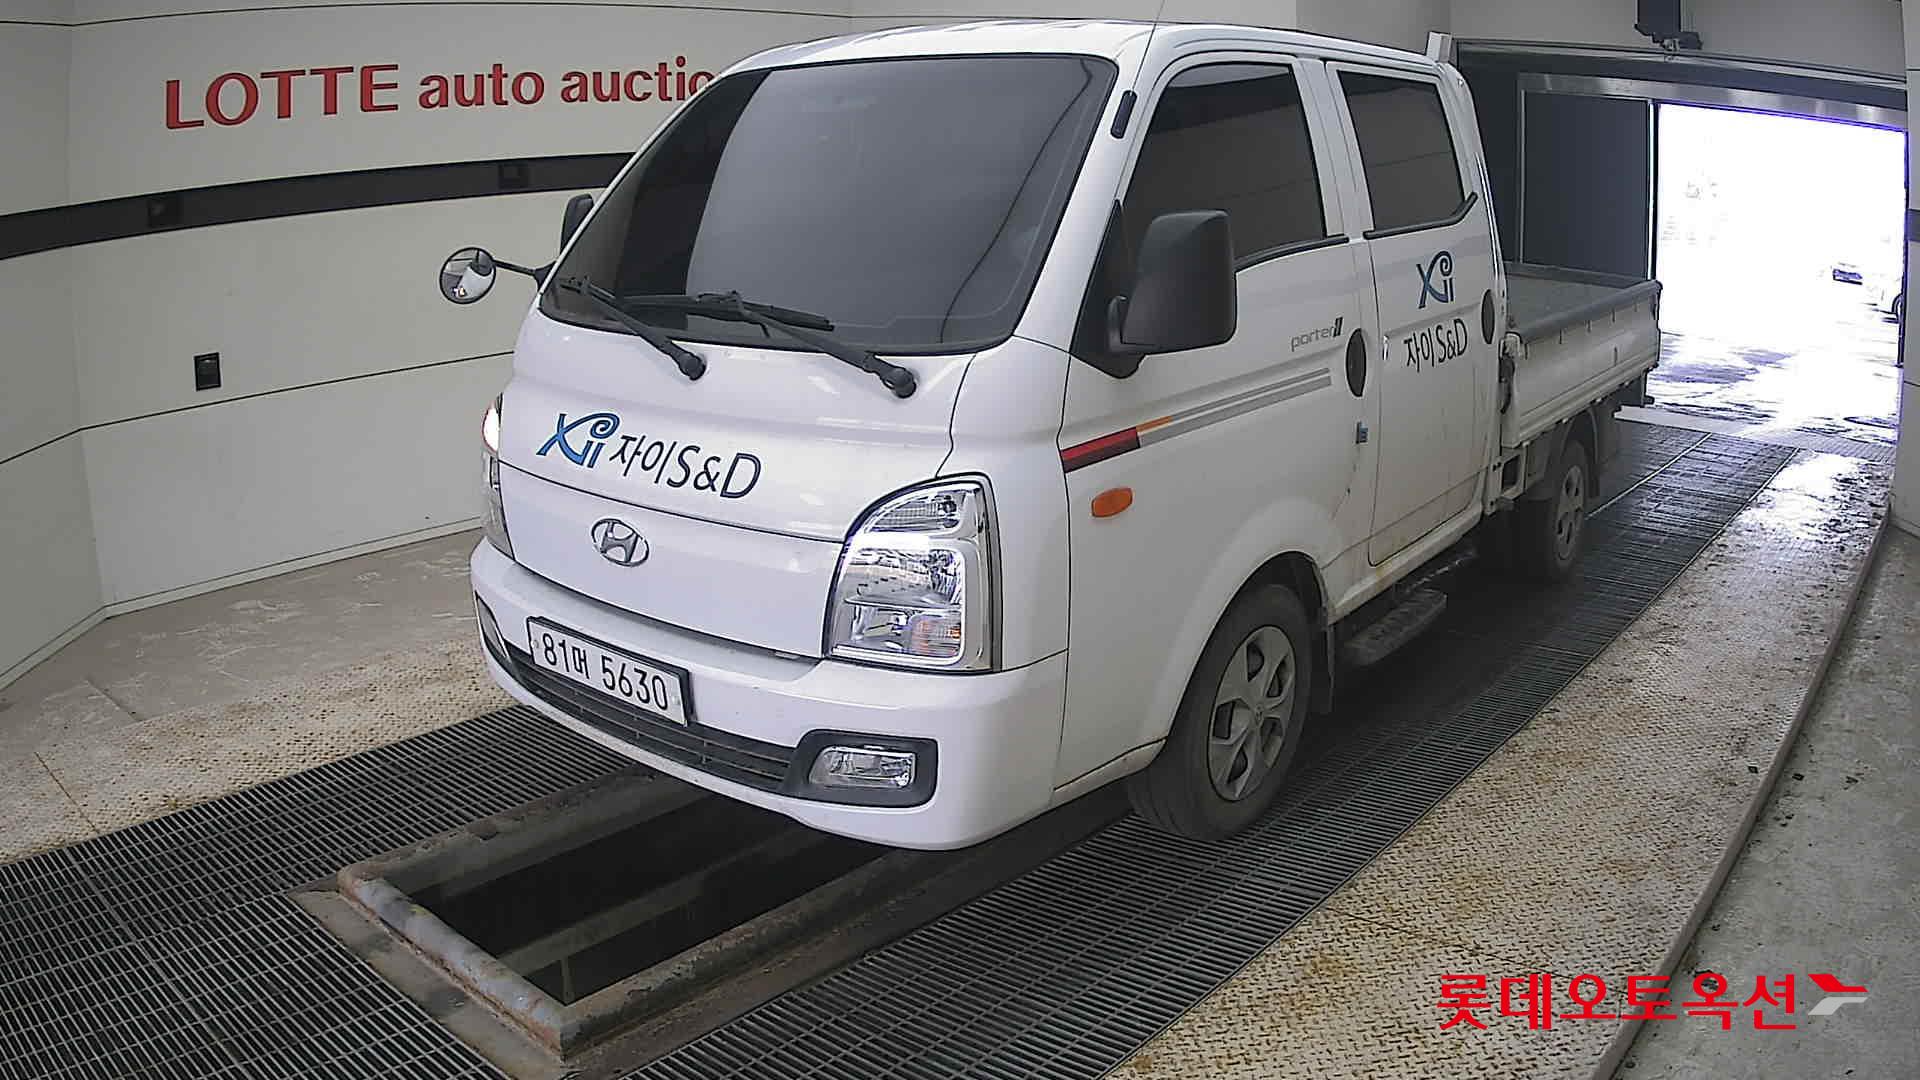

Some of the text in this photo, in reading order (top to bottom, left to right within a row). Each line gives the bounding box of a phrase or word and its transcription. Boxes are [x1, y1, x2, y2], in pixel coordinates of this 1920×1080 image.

[165, 63, 399, 129] LOTTE
[418, 63, 545, 109] auto
[1403, 317, 1468, 373] 자이S&D
[609, 434, 762, 499] 자이S&D
[542, 632, 669, 711] 81머 5630
